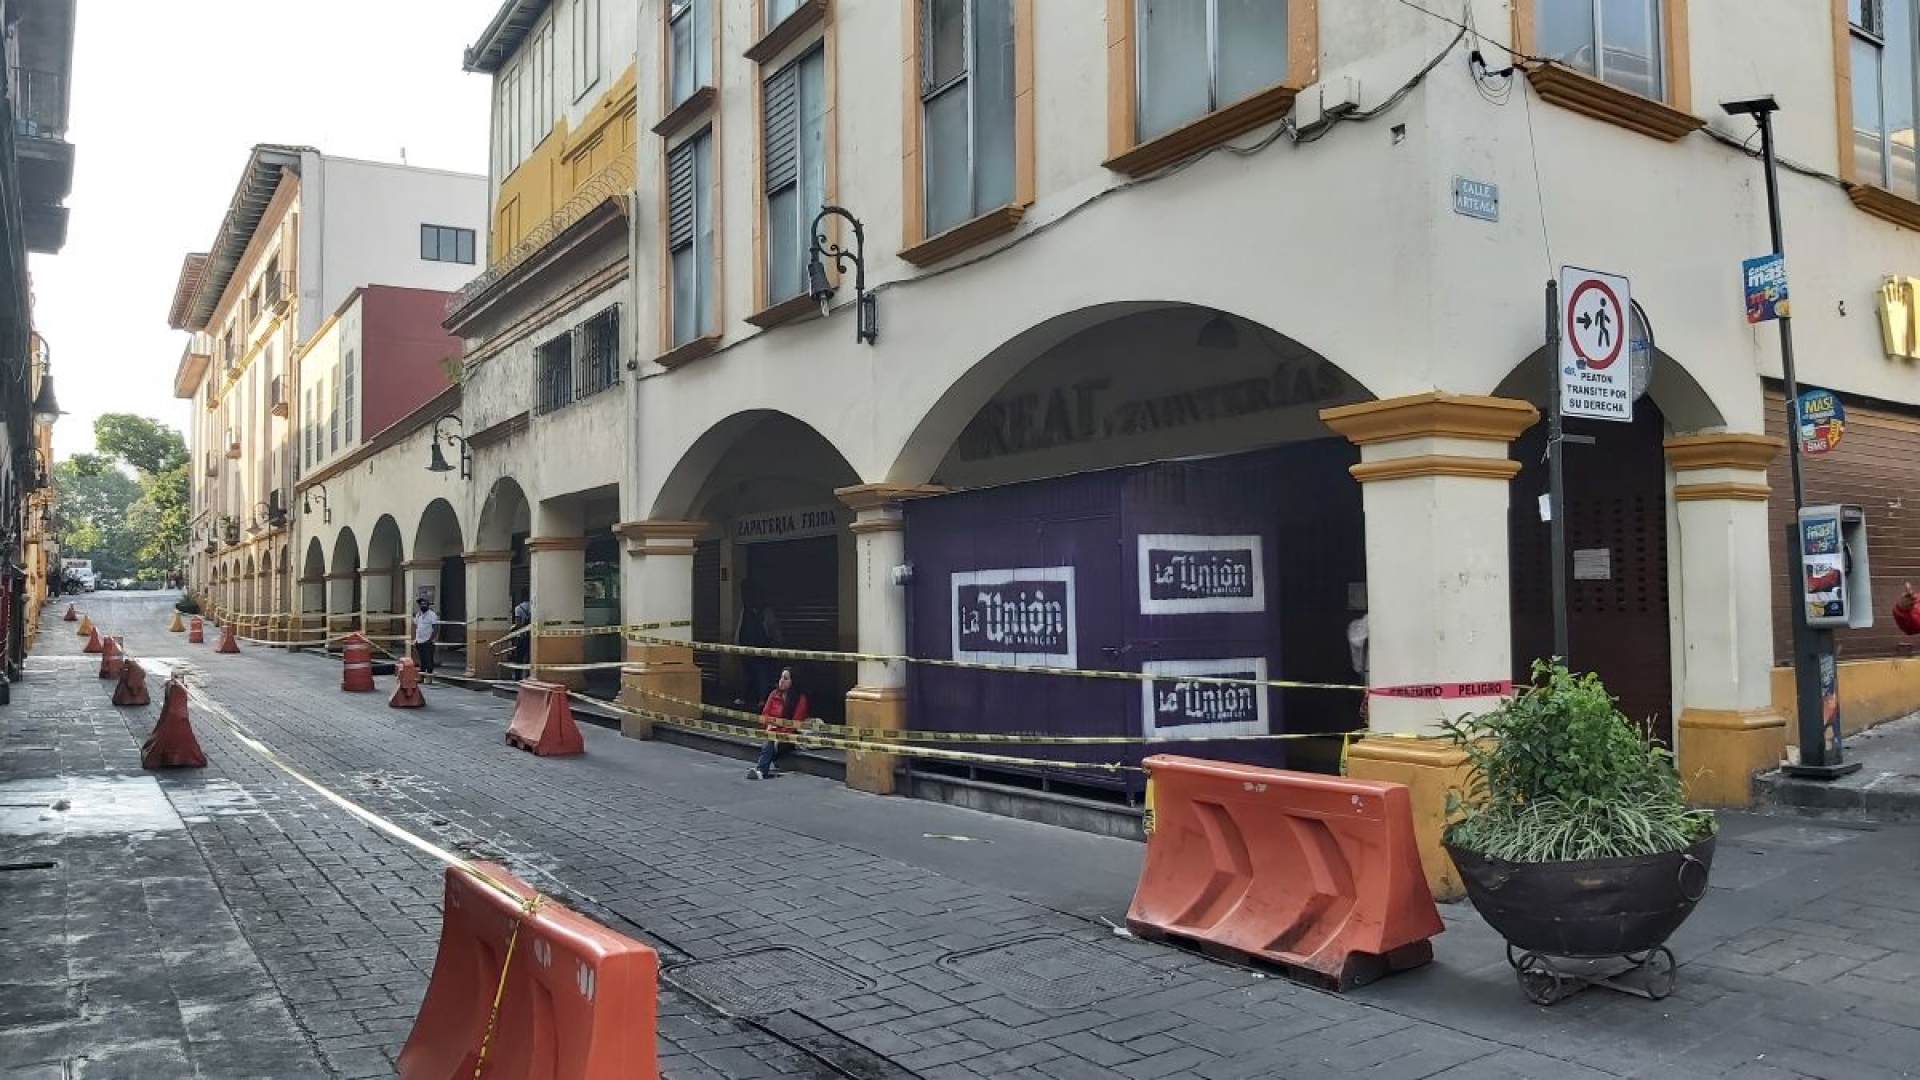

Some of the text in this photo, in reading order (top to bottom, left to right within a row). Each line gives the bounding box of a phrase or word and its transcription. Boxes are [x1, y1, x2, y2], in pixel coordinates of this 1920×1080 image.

[1463, 181, 1491, 198] CALLE
[1580, 372, 1614, 384] PEATON
[1567, 384, 1627, 399] TRANSITE POR
[1569, 398, 1625, 413] SU DERECHA
[1154, 555, 1246, 591] La Unión
[962, 589, 1063, 642] La Unión
[1458, 682, 1502, 696] PELIGRO
[1159, 681, 1252, 717] La Unión
